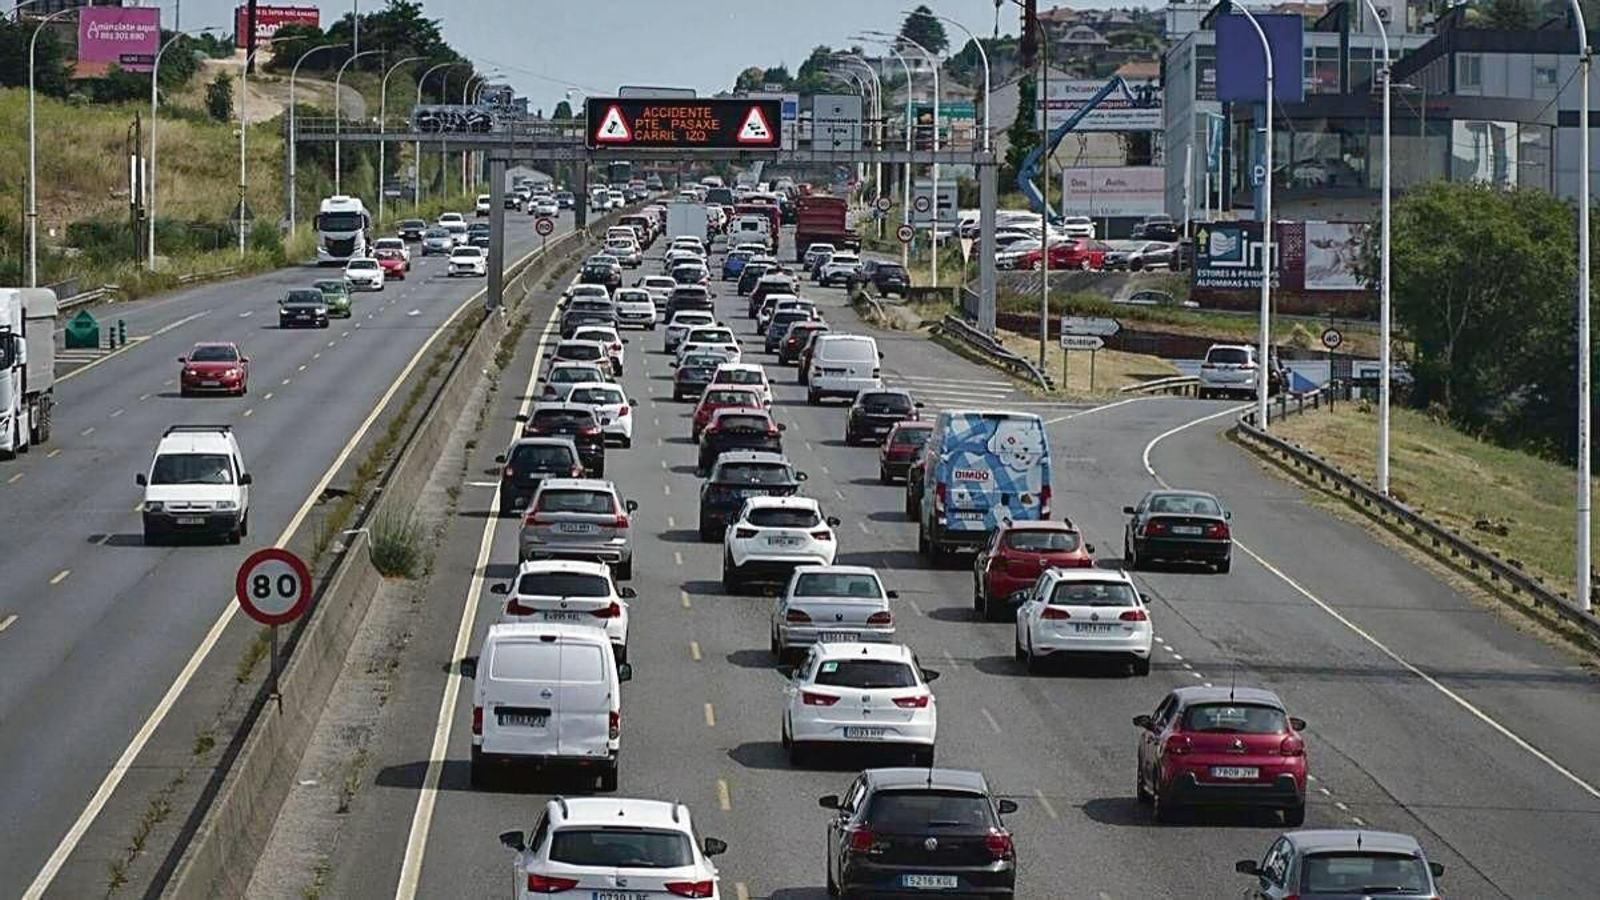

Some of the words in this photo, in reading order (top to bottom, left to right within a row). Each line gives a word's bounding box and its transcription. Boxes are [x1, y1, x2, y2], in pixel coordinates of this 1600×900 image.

[643, 107, 712, 118] ACCIDENTE
[671, 119, 720, 130] PASAXE
[634, 130, 678, 141] CARRIL
[253, 574, 297, 599] 80
